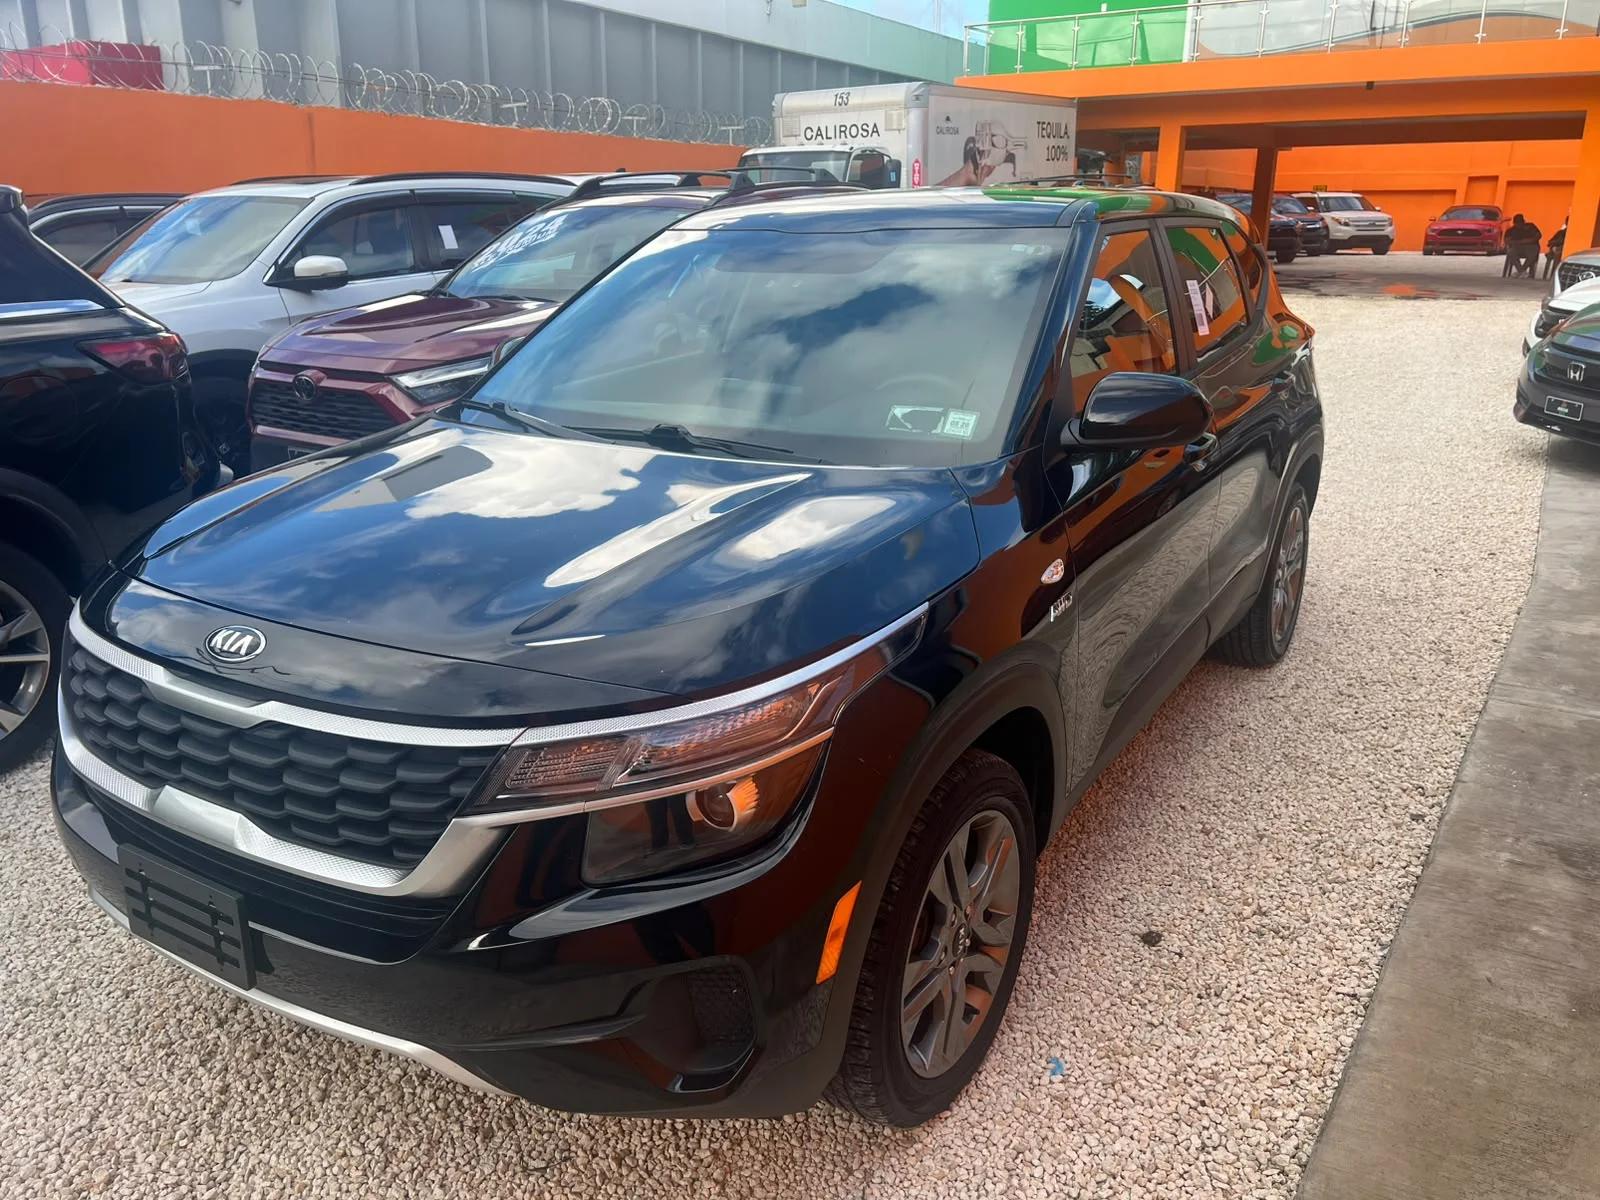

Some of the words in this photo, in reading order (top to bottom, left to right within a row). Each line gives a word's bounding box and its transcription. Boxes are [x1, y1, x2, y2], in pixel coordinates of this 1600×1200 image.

[834, 91, 851, 107] 153
[804, 122, 881, 141] CALIROSA
[1036, 120, 1070, 139] TEQUILA
[1046, 144, 1068, 161] 100%
[209, 629, 255, 656] KIA
